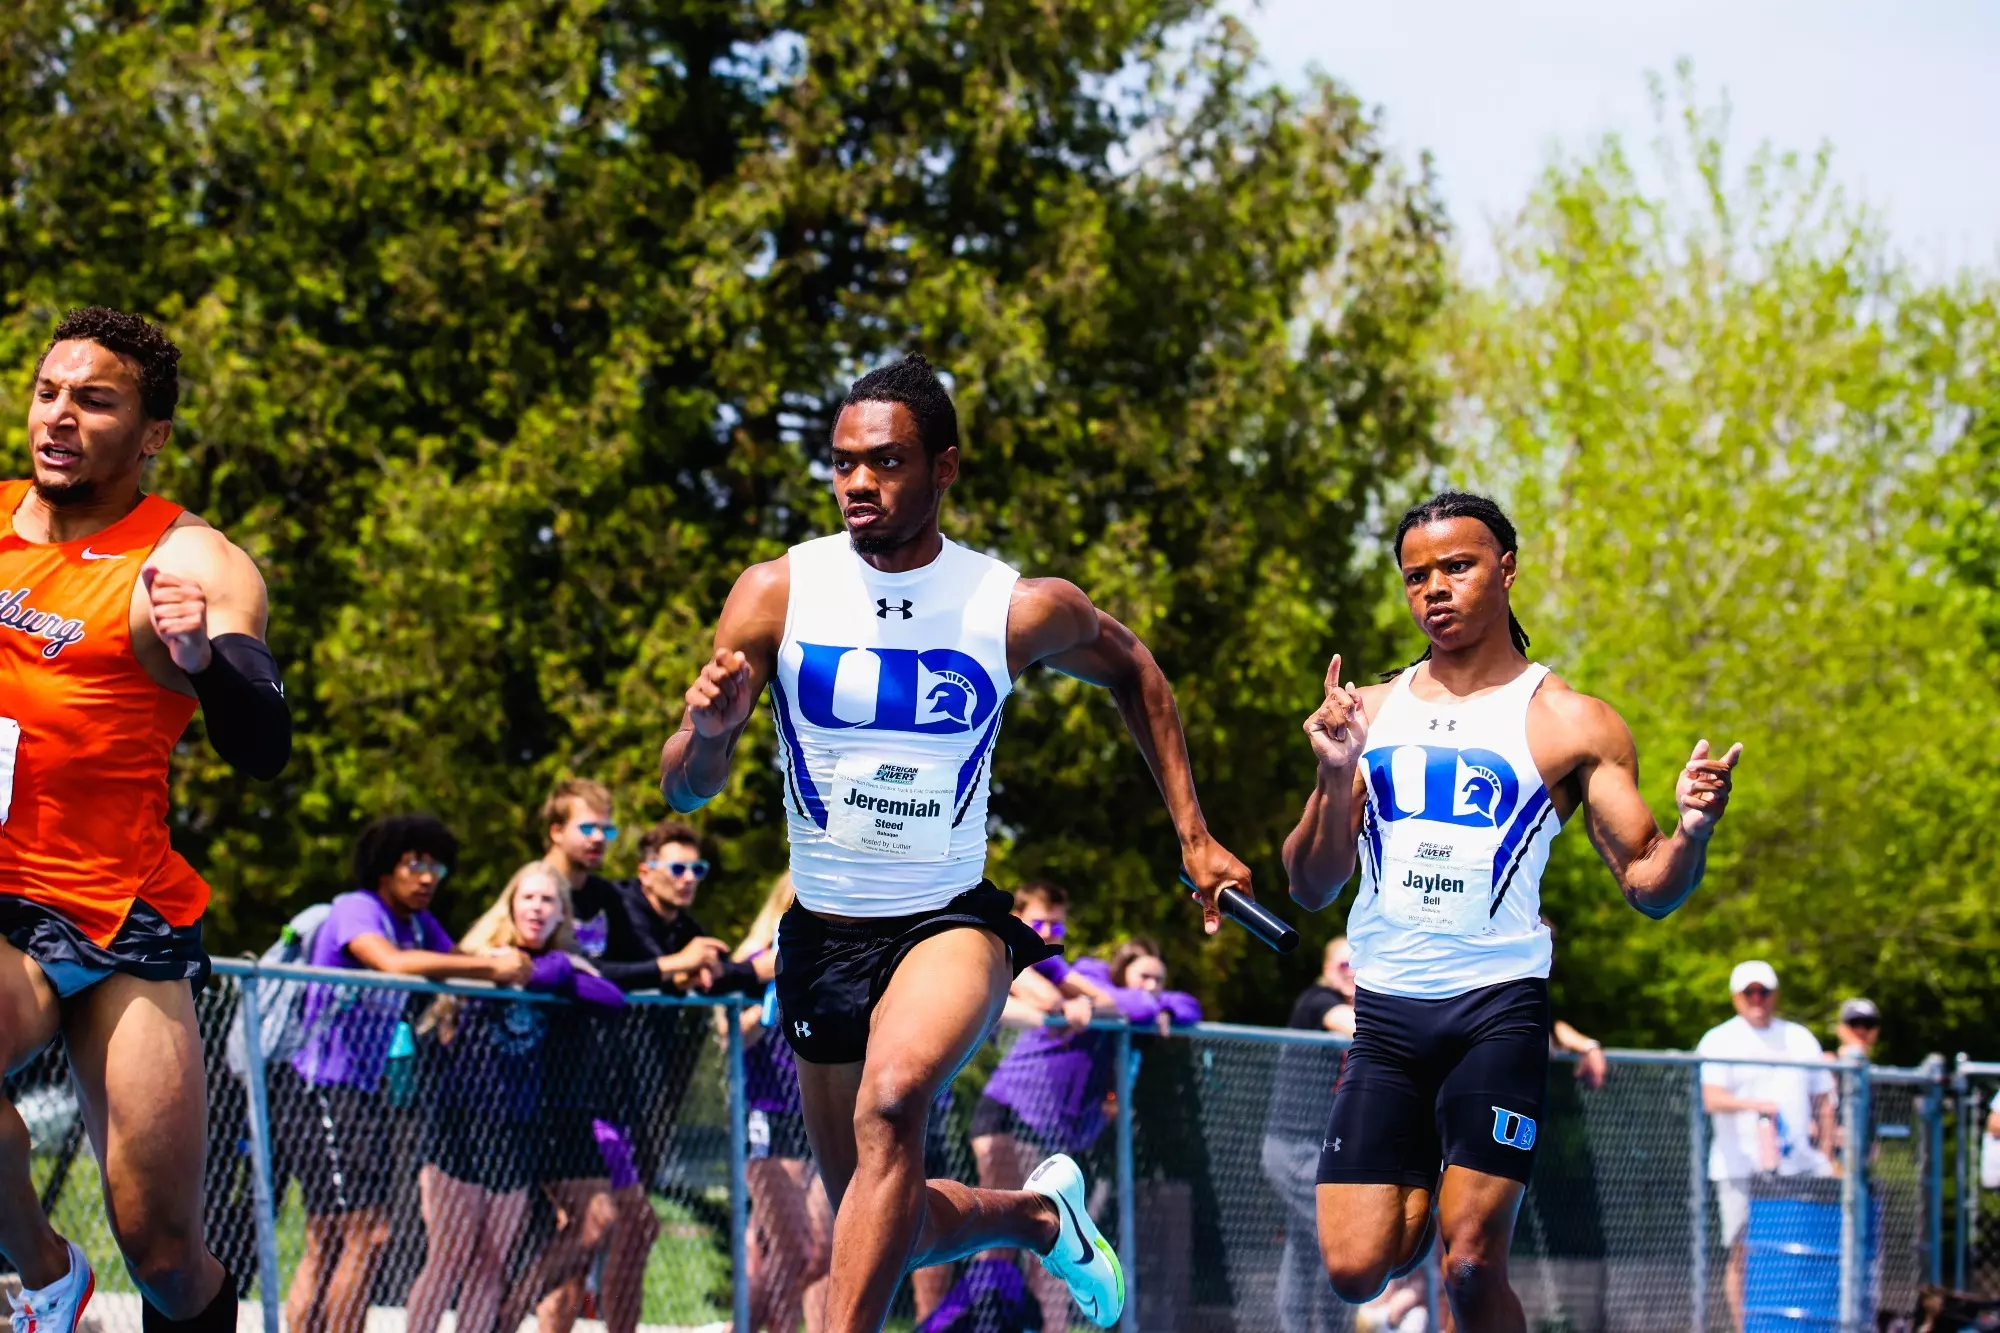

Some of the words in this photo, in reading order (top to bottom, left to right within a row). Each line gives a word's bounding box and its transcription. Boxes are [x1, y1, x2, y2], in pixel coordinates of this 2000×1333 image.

[879, 764, 919, 774] AMERICAN
[874, 770, 917, 781] RIVERS
[844, 788, 940, 817] Jeremiah
[875, 819, 903, 831] Steed
[861, 837, 881, 847] Hosted
[883, 840, 890, 848] by
[1419, 841, 1454, 851] AMERICAN
[1415, 847, 1452, 858] RIVERS
[1402, 870, 1464, 893] Jaylen
[1423, 895, 1440, 905] Bell
